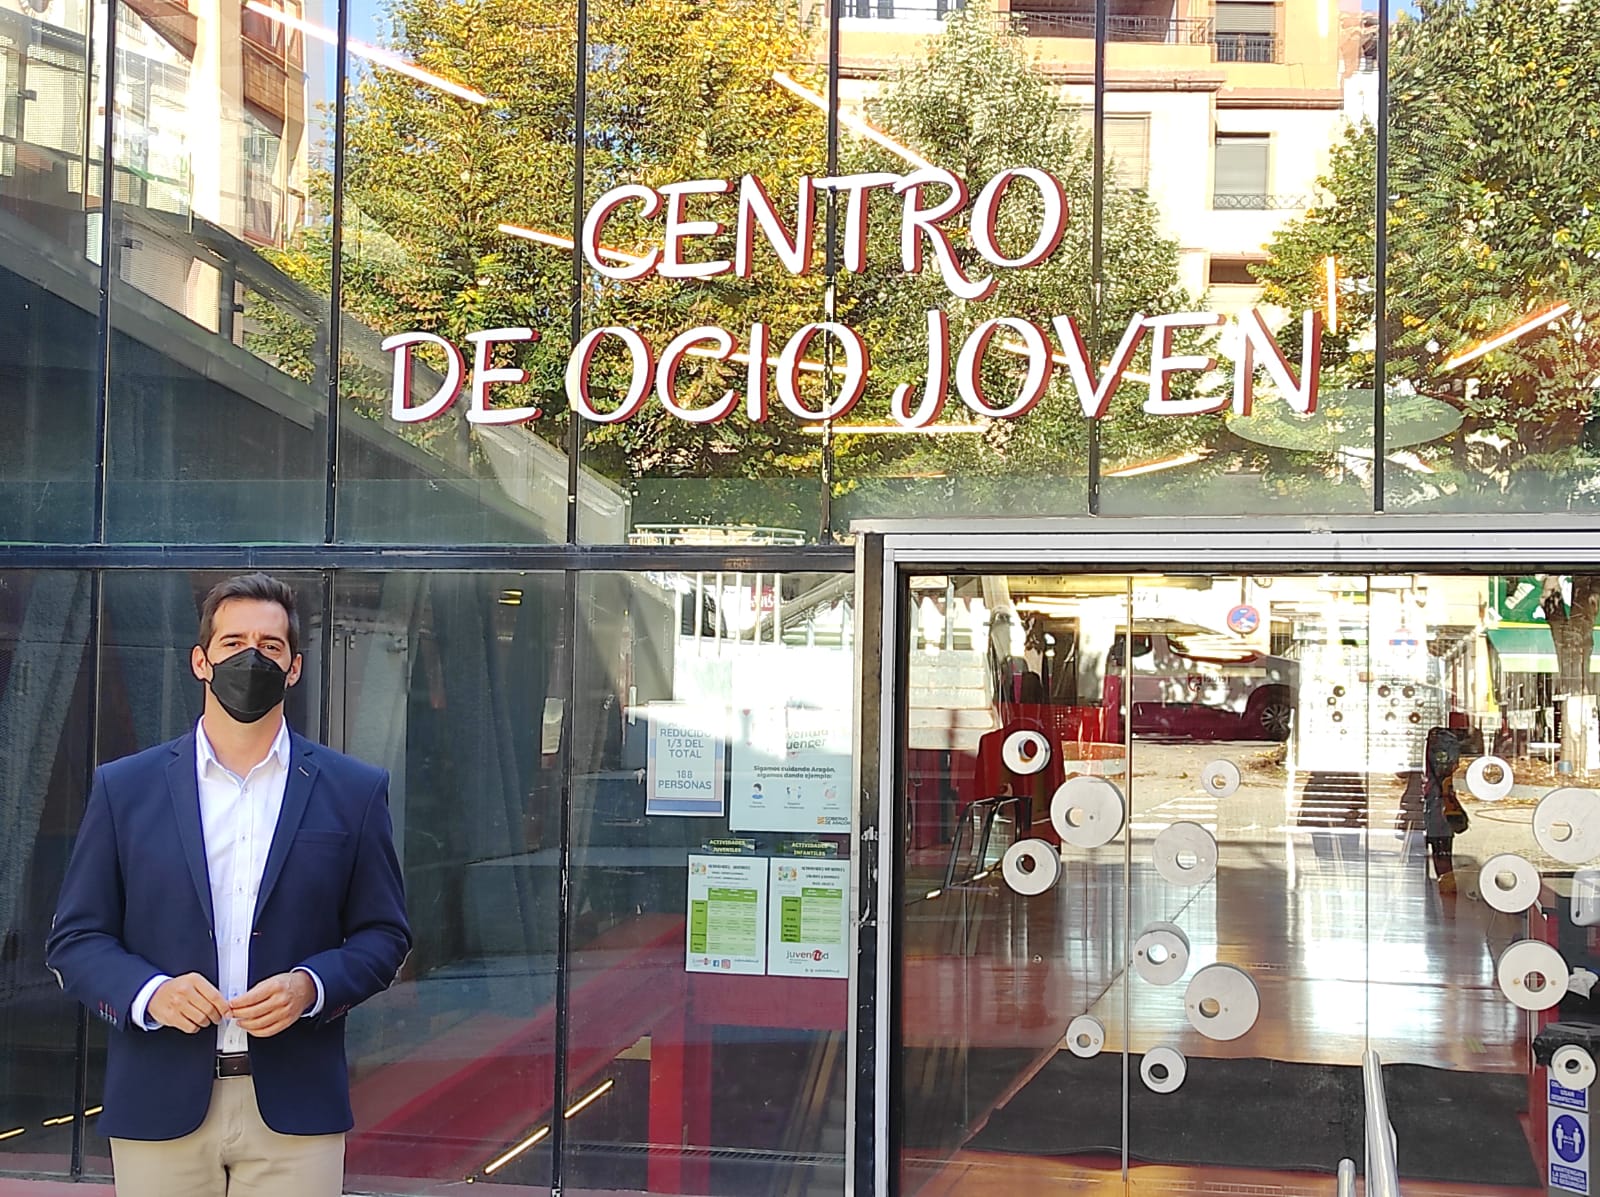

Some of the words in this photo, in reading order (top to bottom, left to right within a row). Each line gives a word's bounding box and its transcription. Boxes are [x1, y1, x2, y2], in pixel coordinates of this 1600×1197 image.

[582, 168, 1068, 300] CENTRO
[381, 327, 543, 425] DE
[565, 321, 870, 424] OCIO
[891, 308, 1322, 428] JOVEN
[667, 739, 682, 748] 1/3
[685, 739, 704, 748] DEL
[669, 749, 702, 759] TOTAL
[753, 765, 780, 773] Sigamos
[781, 765, 810, 773] cuidando
[677, 770, 693, 779] 188
[658, 780, 712, 790] PERSONAS
